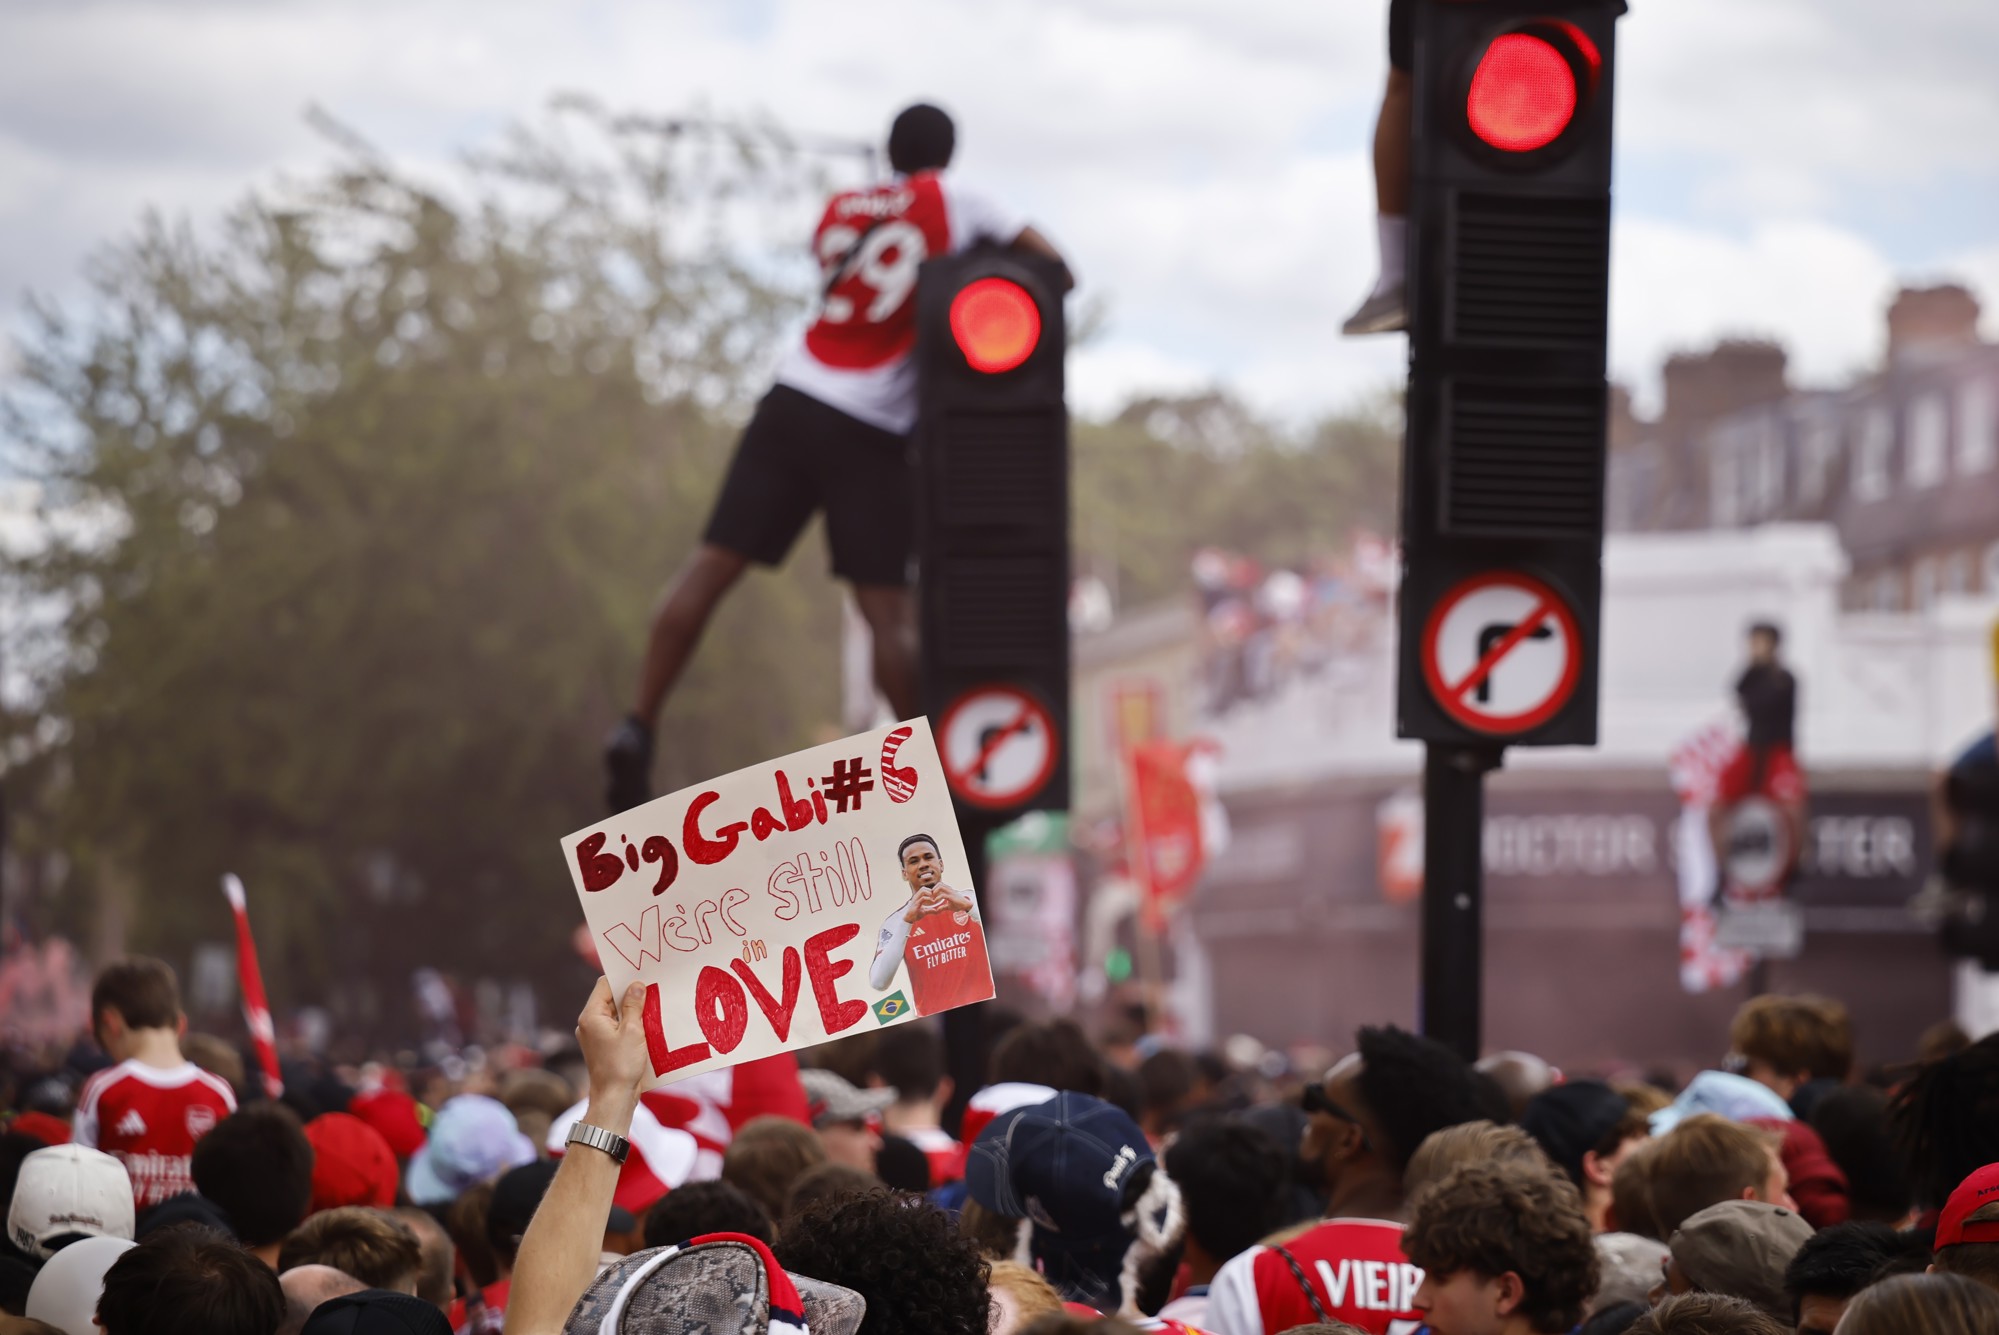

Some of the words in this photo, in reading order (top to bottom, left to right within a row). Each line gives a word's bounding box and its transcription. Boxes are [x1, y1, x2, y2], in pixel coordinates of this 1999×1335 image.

[820, 220, 928, 325] 29
[575, 832, 679, 896] Big
[742, 939, 768, 964] in
[912, 931, 971, 960] Emirates
[926, 955, 939, 969] FLY
[941, 946, 967, 964] BETTER
[642, 923, 868, 1078] LOVE
[1314, 1258, 1426, 1313] VIEIR
